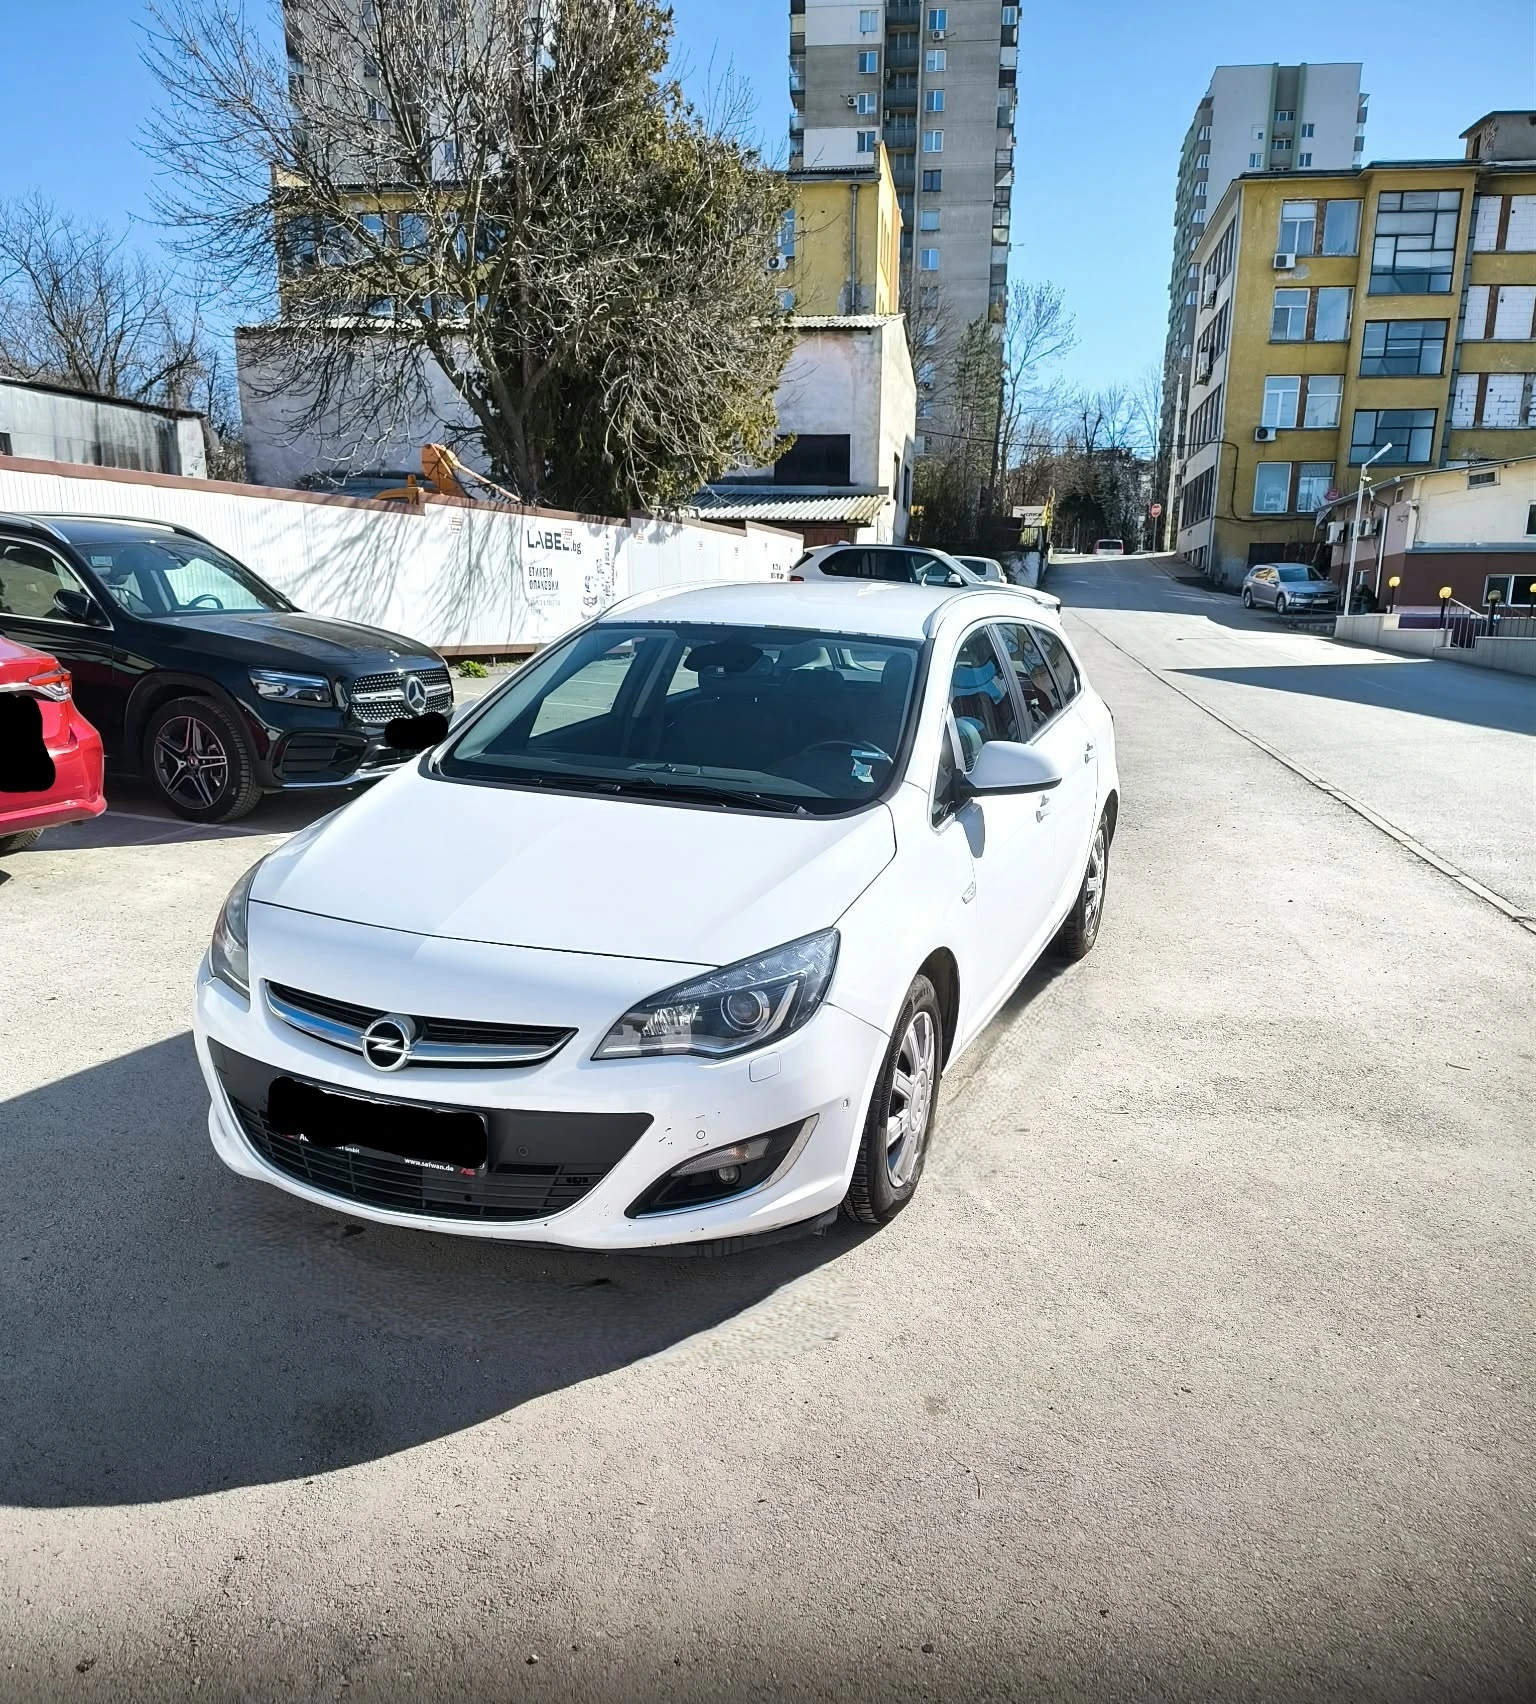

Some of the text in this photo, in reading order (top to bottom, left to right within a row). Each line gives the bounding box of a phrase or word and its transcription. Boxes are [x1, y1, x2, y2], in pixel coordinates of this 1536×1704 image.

[528, 567, 553, 578] ЕТИКЕТИ
[529, 580, 559, 591] ОПАКОВКИ
[404, 1158, 454, 1172] www.safwan.de
